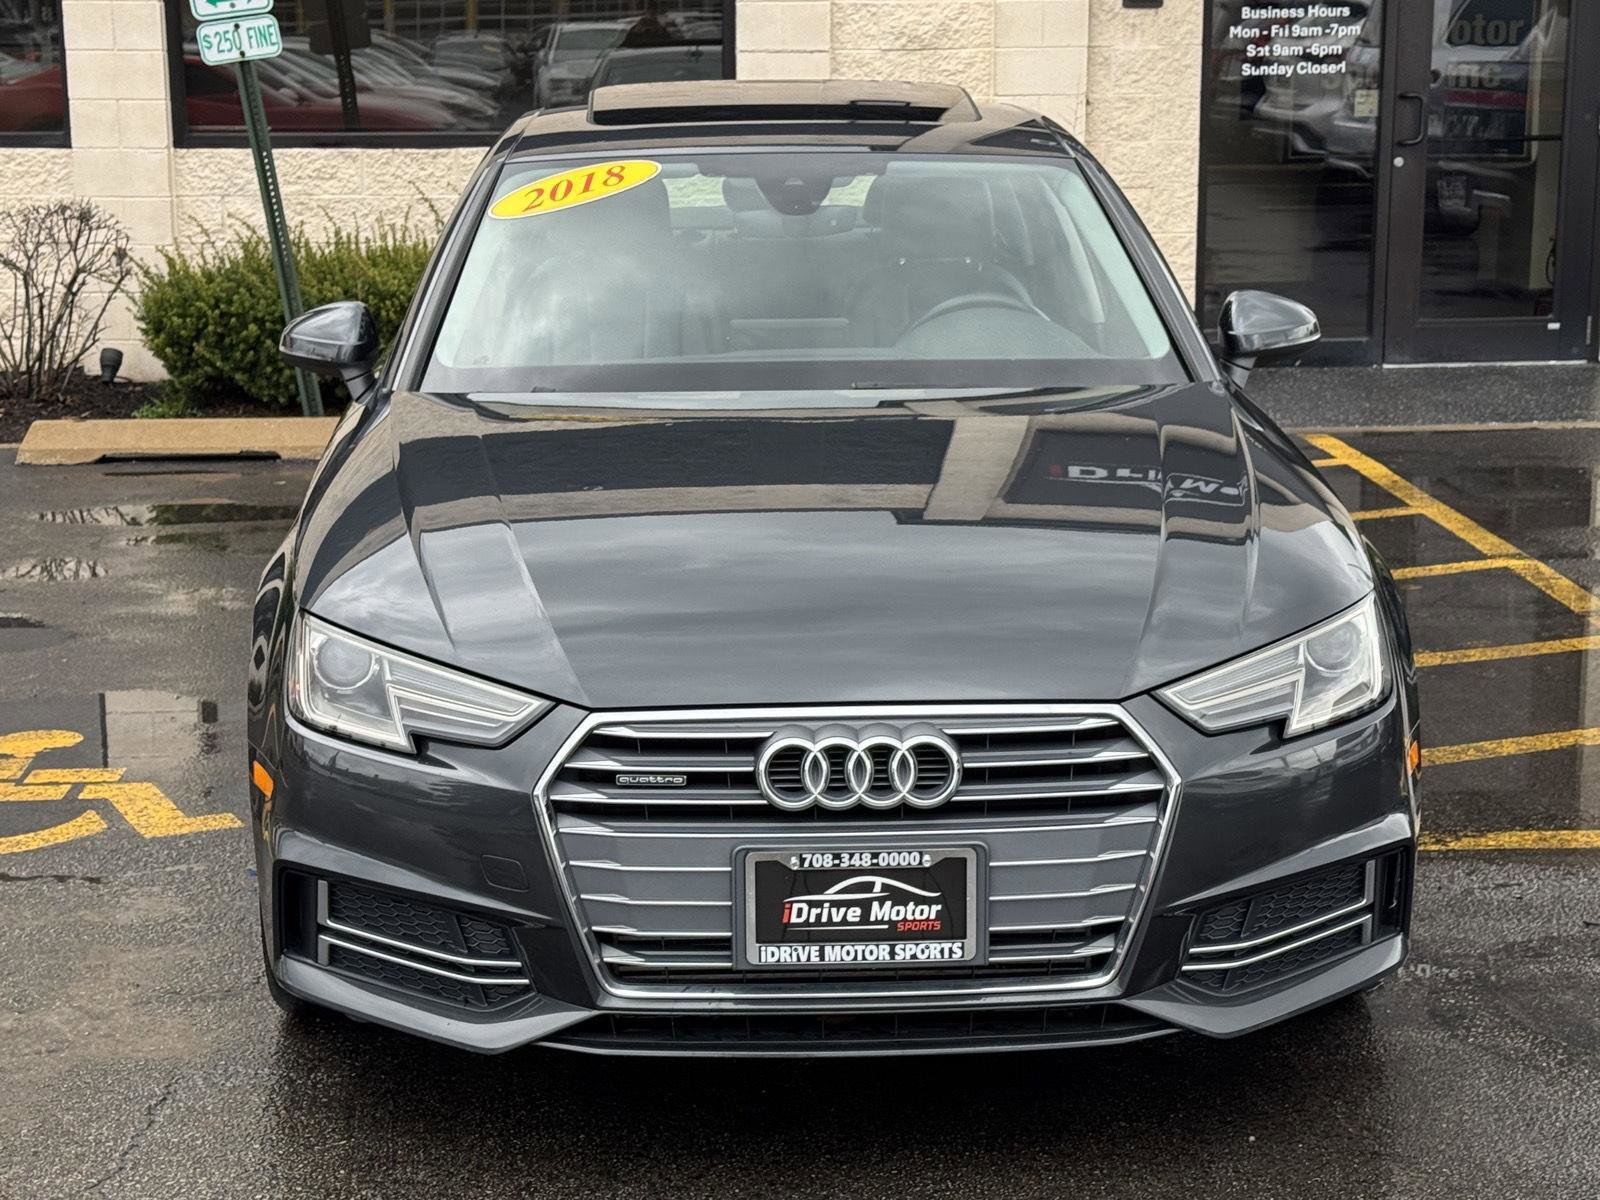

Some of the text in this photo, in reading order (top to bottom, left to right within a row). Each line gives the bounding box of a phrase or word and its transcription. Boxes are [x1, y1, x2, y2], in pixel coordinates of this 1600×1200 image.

[1241, 5, 1350, 19] Business Hours
[246, 24, 279, 49] FINE
[1229, 25, 1260, 39] Mon
[1271, 24, 1289, 38] Fri
[1291, 25, 1322, 37] 9am
[1246, 44, 1270, 57] Sat
[1273, 45, 1303, 57] 9am
[1241, 60, 1346, 78] Sunday Closed
[522, 165, 626, 213] 2018
[619, 775, 684, 785] quattro
[801, 851, 920, 868] 708-348-0000
[782, 900, 942, 924] iDrive Motor
[897, 920, 942, 932] SPORTS
[825, 944, 891, 962] MOTOR
[894, 942, 963, 961] SPORTS
